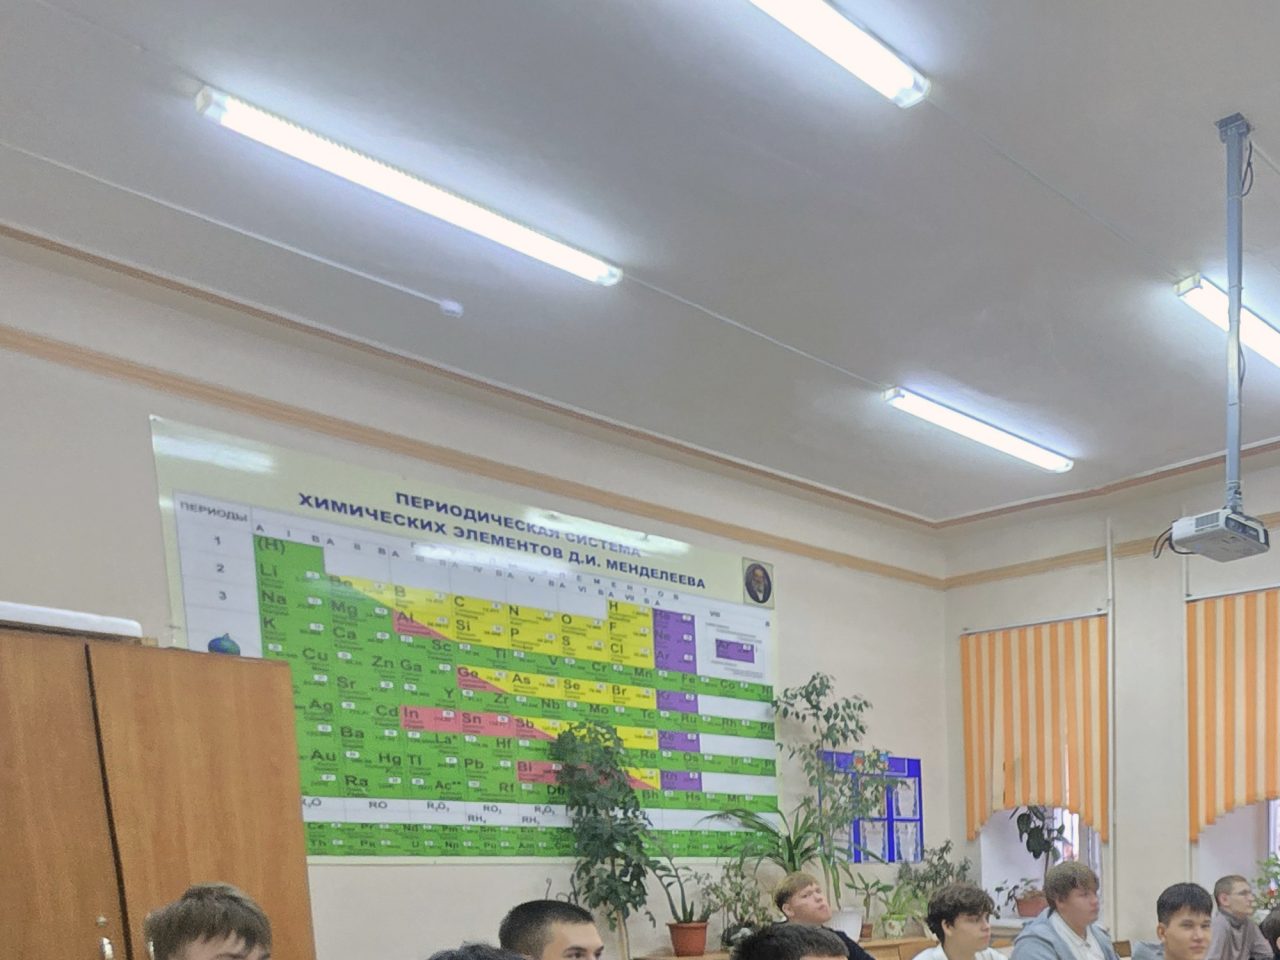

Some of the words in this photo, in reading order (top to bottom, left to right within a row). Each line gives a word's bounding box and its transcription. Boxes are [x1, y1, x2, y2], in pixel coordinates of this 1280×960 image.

[180, 500, 248, 522] ПЕРИОДЫ
[396, 491, 560, 540] ПЕРИОДИЧЕСКАЯ
[564, 531, 642, 558] СИСТЕМА
[298, 491, 448, 536] ХИМИЧЕСКИХ
[453, 525, 563, 559] ЭЛЕМЕНТОВ
[568, 550, 601, 568] Д.И.
[606, 558, 706, 590] МЕНДЕЛЕЕВА
[214, 535, 222, 546] 1
[257, 537, 286, 556] (H)
[608, 601, 618, 612] H
[216, 563, 225, 573] 2
[260, 563, 278, 578] Li
[394, 585, 406, 598] B
[454, 595, 465, 608] C
[508, 605, 519, 617] N
[561, 613, 573, 625] O
[609, 621, 617, 632] F
[219, 590, 227, 601] 3
[262, 590, 287, 606] Na
[331, 600, 358, 617] Mg
[456, 618, 471, 632] Si
[510, 627, 520, 638] P
[562, 635, 571, 647] S
[610, 642, 624, 655] Cl
[263, 616, 277, 630] K
[333, 626, 358, 640] Ca
[431, 640, 451, 652] Sc
[548, 655, 558, 666] V
[592, 661, 608, 673] Cr
[634, 667, 653, 679] Mn
[302, 647, 329, 662] Cu
[371, 655, 395, 669] Zn
[400, 659, 422, 673] Ga
[457, 666, 479, 679] Ge
[512, 673, 532, 685] As
[563, 678, 581, 691] Se
[611, 684, 628, 696] Br
[309, 699, 334, 714] Ag
[375, 703, 399, 717] Cd
[403, 706, 420, 719] In
[462, 712, 482, 725] Sn
[516, 718, 535, 730] Sb
[336, 676, 357, 690] Sr
[443, 688, 454, 699] Y
[494, 693, 509, 704] Zr
[541, 698, 561, 710] Nb
[589, 703, 610, 715] Mo
[311, 749, 337, 762] Au
[378, 752, 402, 767] Hg
[464, 758, 484, 769] Pb
[340, 725, 365, 739] Ba
[496, 738, 512, 749] Hf
[344, 774, 369, 787] Ra
[498, 783, 514, 793] Rf
[368, 801, 388, 809] RO
